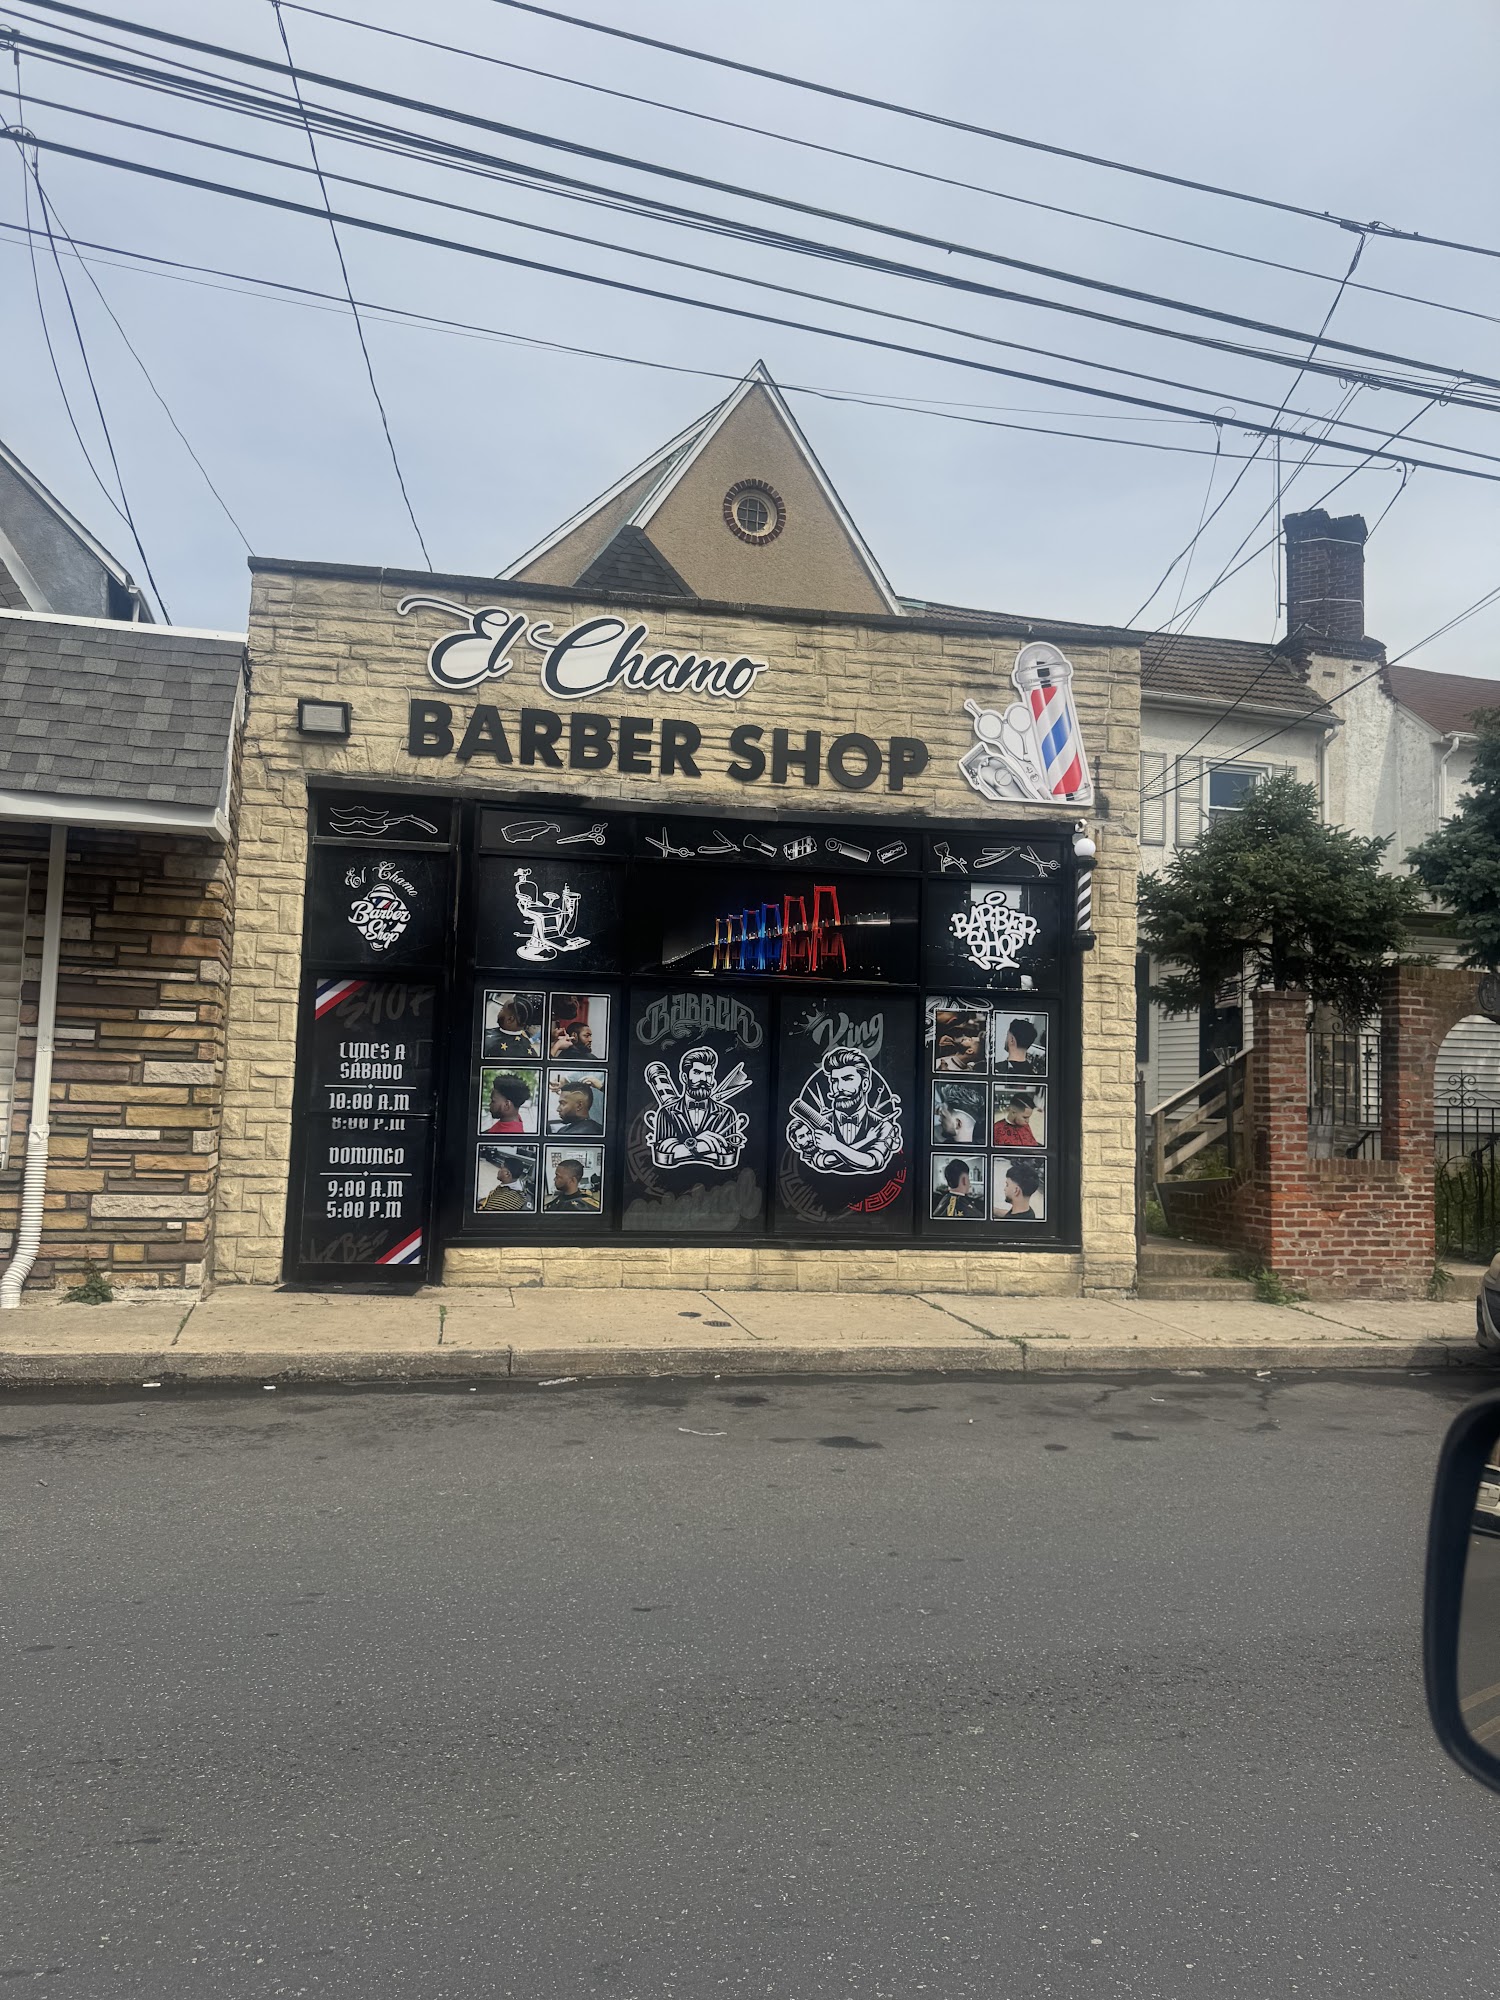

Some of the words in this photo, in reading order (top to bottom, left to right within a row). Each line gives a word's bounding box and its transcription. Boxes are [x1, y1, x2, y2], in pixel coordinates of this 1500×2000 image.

[400, 596, 528, 688] El
[527, 616, 768, 699] Chamo
[409, 698, 702, 777] BARBER
[727, 724, 930, 791] SHOP
[345, 867, 367, 889] El
[372, 861, 418, 898] Chamo
[348, 900, 411, 925] Barber
[951, 904, 1038, 945] BARBER
[365, 920, 400, 950] Shop
[967, 930, 1024, 958] SHOP
[812, 1011, 884, 1060] King
[339, 1042, 390, 1061] LUNES
[394, 1043, 406, 1061] A
[340, 1057, 403, 1080] SÁBADO
[328, 1092, 373, 1110] 10:00
[377, 1093, 410, 1111] A.M
[329, 1147, 404, 1165] DOMINGO
[328, 1180, 366, 1198] 9:00
[370, 1180, 403, 1198] A.M
[326, 1201, 364, 1219] 5:00
[368, 1201, 402, 1219] P.M
